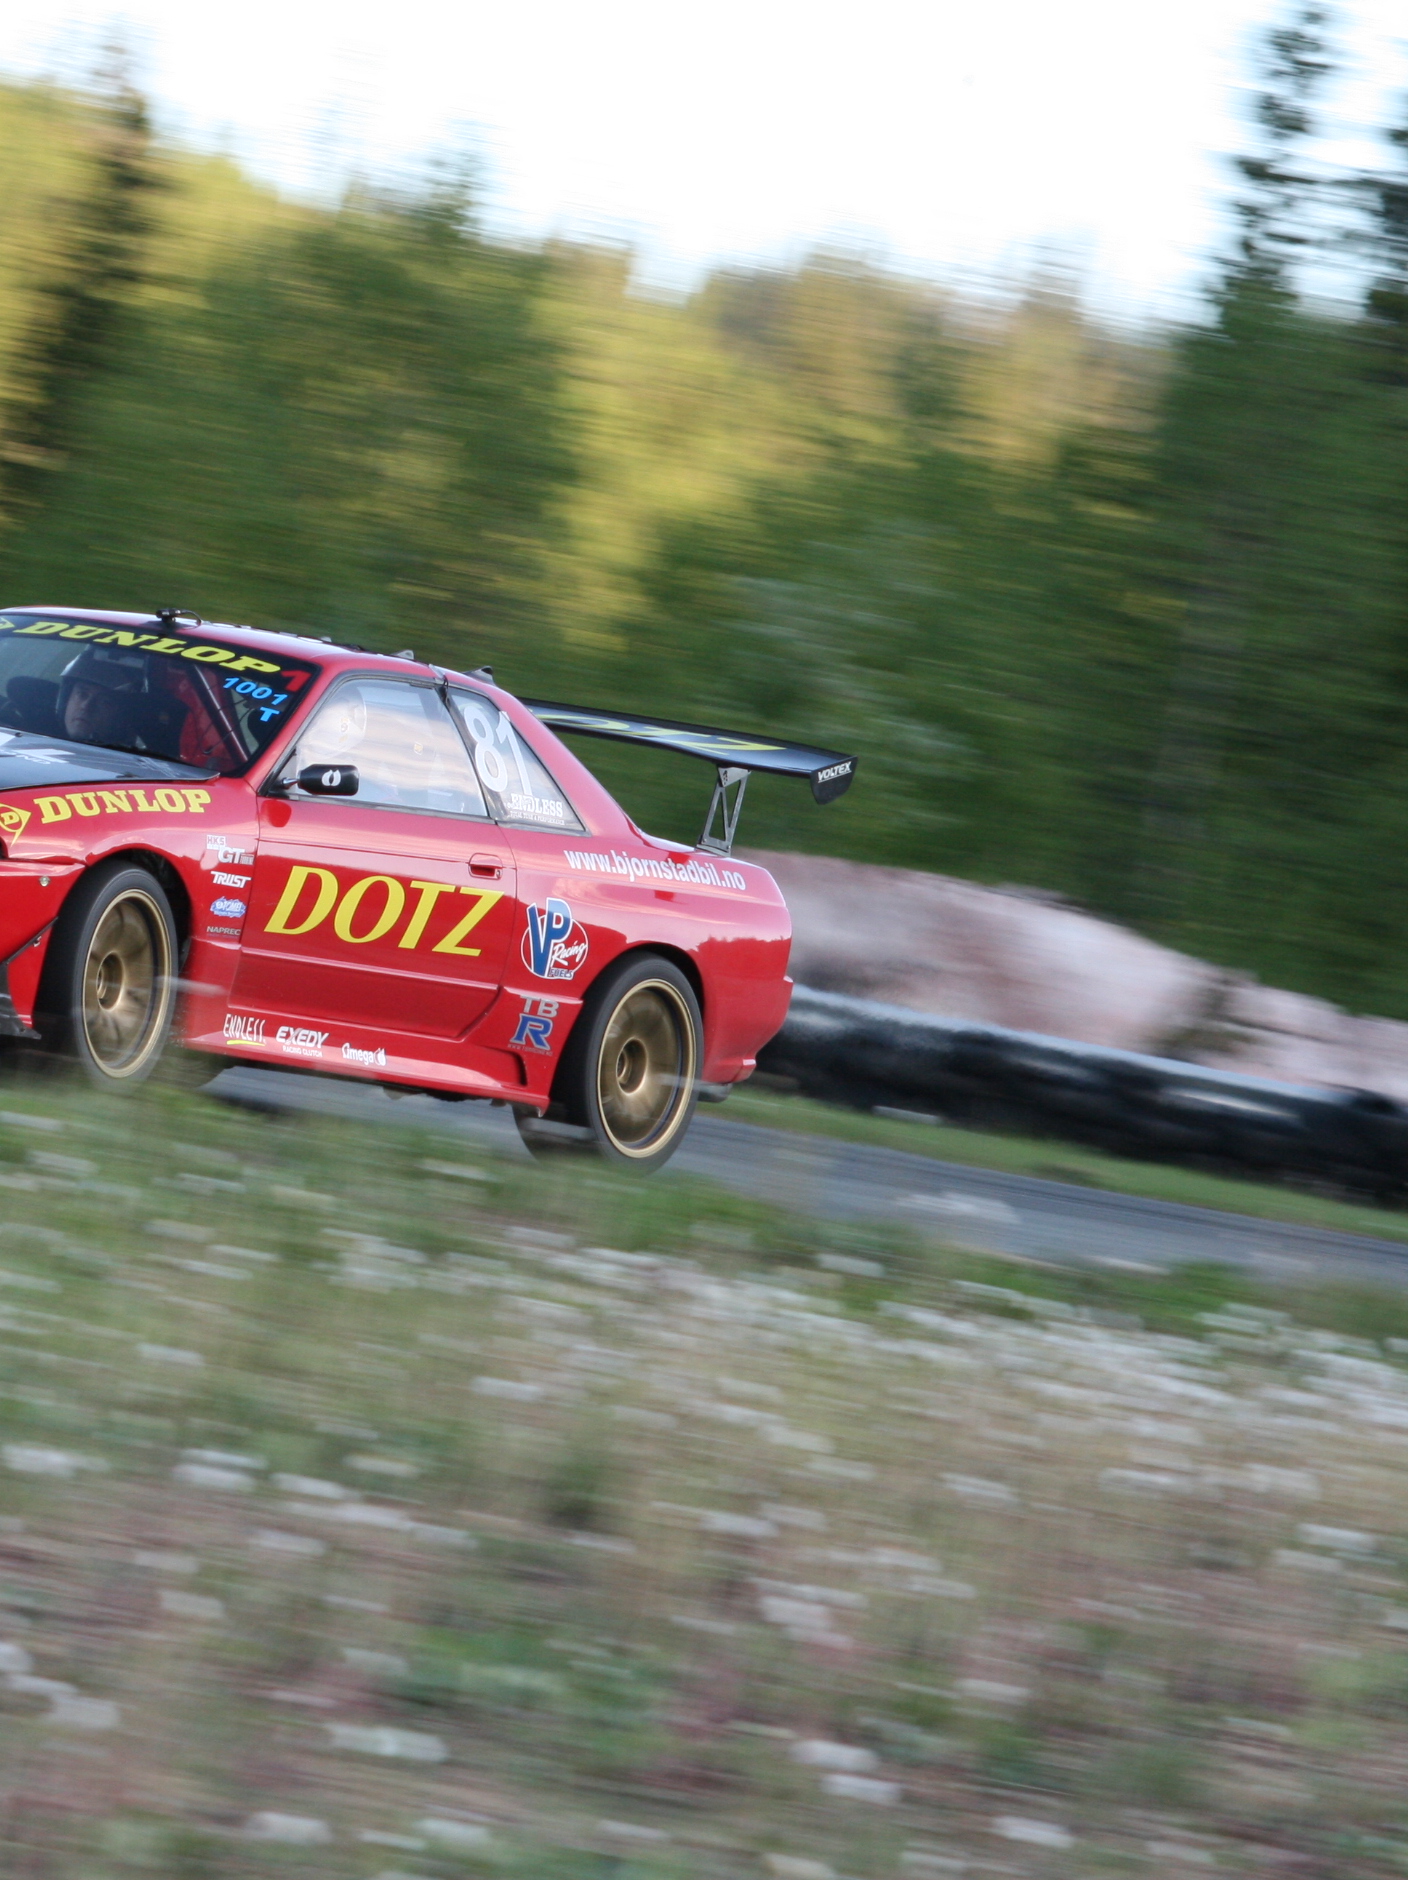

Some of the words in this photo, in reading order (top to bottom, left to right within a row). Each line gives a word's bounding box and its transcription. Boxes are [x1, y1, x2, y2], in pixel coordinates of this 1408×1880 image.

[14, 621, 281, 674] DUNLOP
[223, 677, 288, 706] 1001
[259, 706, 280, 722] T
[463, 705, 532, 796] 81
[818, 761, 852, 782] VOLTEX
[34, 788, 211, 824] DUNLOP
[510, 793, 563, 817] ENDLESS
[207, 835, 226, 846] HKS
[218, 846, 245, 864] GT
[210, 870, 252, 888] TRUST
[563, 850, 746, 890] www.bjornstadbil.no
[264, 866, 504, 956] DOTZ
[207, 926, 241, 936] NAPREC
[526, 897, 573, 977] VP
[223, 1013, 266, 1043] ENDLESS
[276, 1026, 329, 1048] EXEDY
